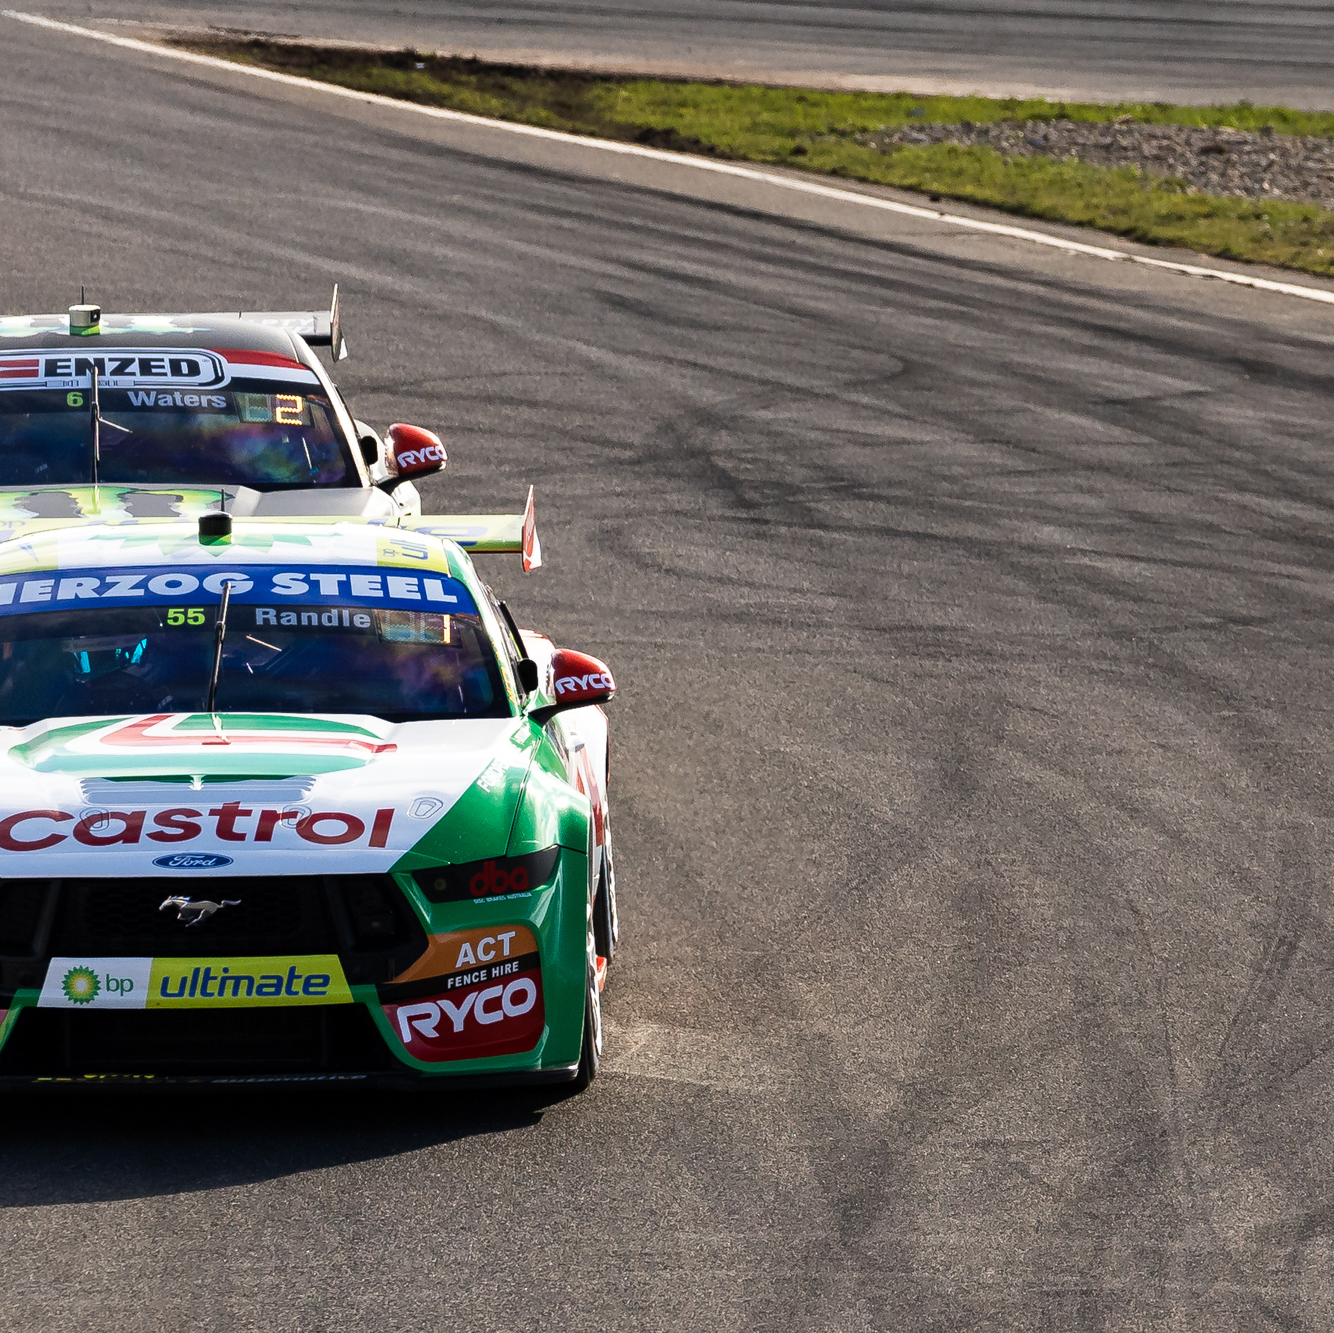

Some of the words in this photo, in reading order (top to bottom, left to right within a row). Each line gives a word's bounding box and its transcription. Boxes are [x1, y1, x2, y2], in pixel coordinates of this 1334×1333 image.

[43, 357, 203, 379] ENZED
[66, 391, 84, 407] 6
[129, 391, 227, 410] Waters
[275, 394, 303, 426] 2
[269, 571, 459, 604] STEEL
[166, 607, 207, 627] 55
[255, 607, 371, 629] Randle
[167, 853, 217, 869] Ford
[469, 860, 529, 897] dba
[454, 930, 516, 969] ACT
[105, 973, 135, 997] bp
[159, 965, 331, 998] ultimate
[447, 970, 488, 990] FENCE
[491, 961, 520, 979] HIRE
[396, 976, 537, 1044] RYCO
